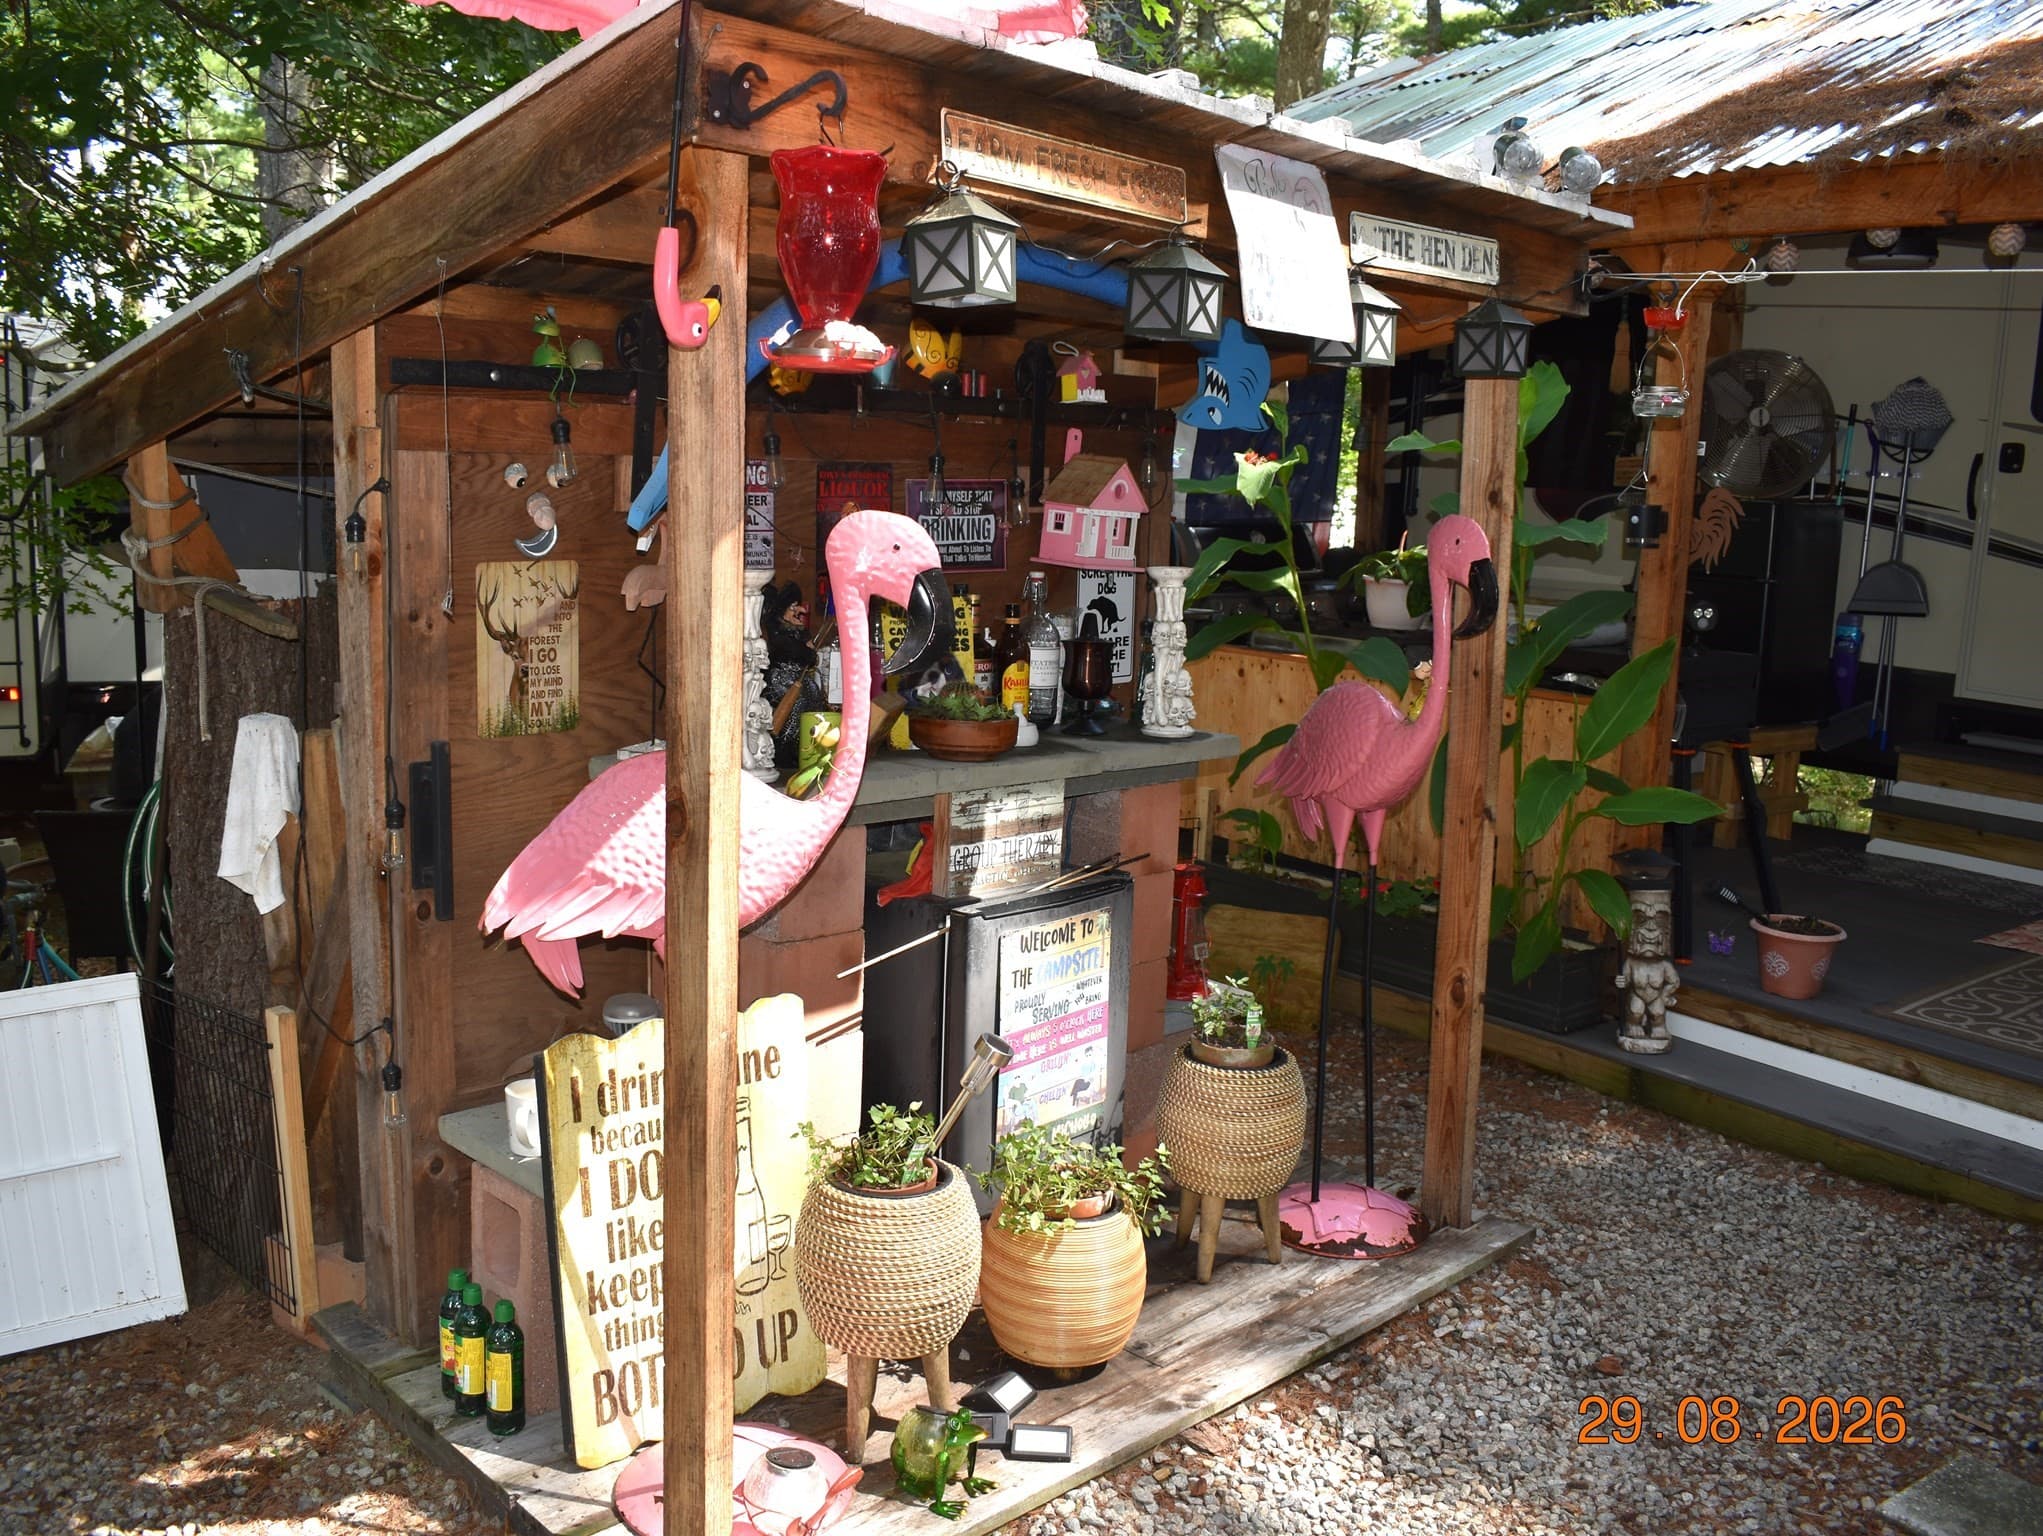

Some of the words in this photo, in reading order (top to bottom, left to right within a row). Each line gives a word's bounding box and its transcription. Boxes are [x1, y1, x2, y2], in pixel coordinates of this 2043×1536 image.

[957, 126, 1024, 180] FARM
[1034, 145, 1107, 195] FRESH
[1375, 225, 1416, 260] THE
[1421, 233, 1456, 271] HEN
[1461, 243, 1494, 276] DEN
[818, 480, 890, 497] LIQUOR
[745, 495, 768, 506] EER
[1081, 568, 1115, 579] SCRE
[559, 600, 576, 611] AND
[554, 612, 572, 621] INTO
[548, 623, 563, 633] THE
[529, 635, 561, 646] FOREST
[529, 649, 534, 664] I
[537, 647, 557, 663] GO
[1111, 650, 1127, 661] HE
[529, 666, 540, 676] TO
[542, 665, 561, 675] LOSE
[529, 679, 542, 689] MY
[543, 677, 563, 687] MIND
[530, 690, 546, 700] AND
[547, 689, 563, 698] FIND
[530, 701, 555, 718] MY
[529, 719, 553, 729] SOUL
[953, 843, 999, 873] GROUP
[1001, 833, 1060, 864] THERAPY
[1020, 921, 1076, 954] WELCOME
[1080, 917, 1094, 940] TO
[1011, 966, 1033, 990] THE
[1014, 991, 1046, 1014] PROUDLY
[1085, 991, 1102, 1005] BRING
[1032, 999, 1070, 1025] SERVING
[1022, 1025, 1051, 1046] ALWAYS
[1087, 1007, 1105, 1023] HERE
[1059, 1032, 1075, 1045] WELL
[569, 1075, 582, 1124] I
[590, 1118, 662, 1156] becau
[578, 1166, 593, 1218] I
[608, 1148, 665, 1211] DO
[605, 1215, 665, 1264] like
[755, 1308, 799, 1370] UP
